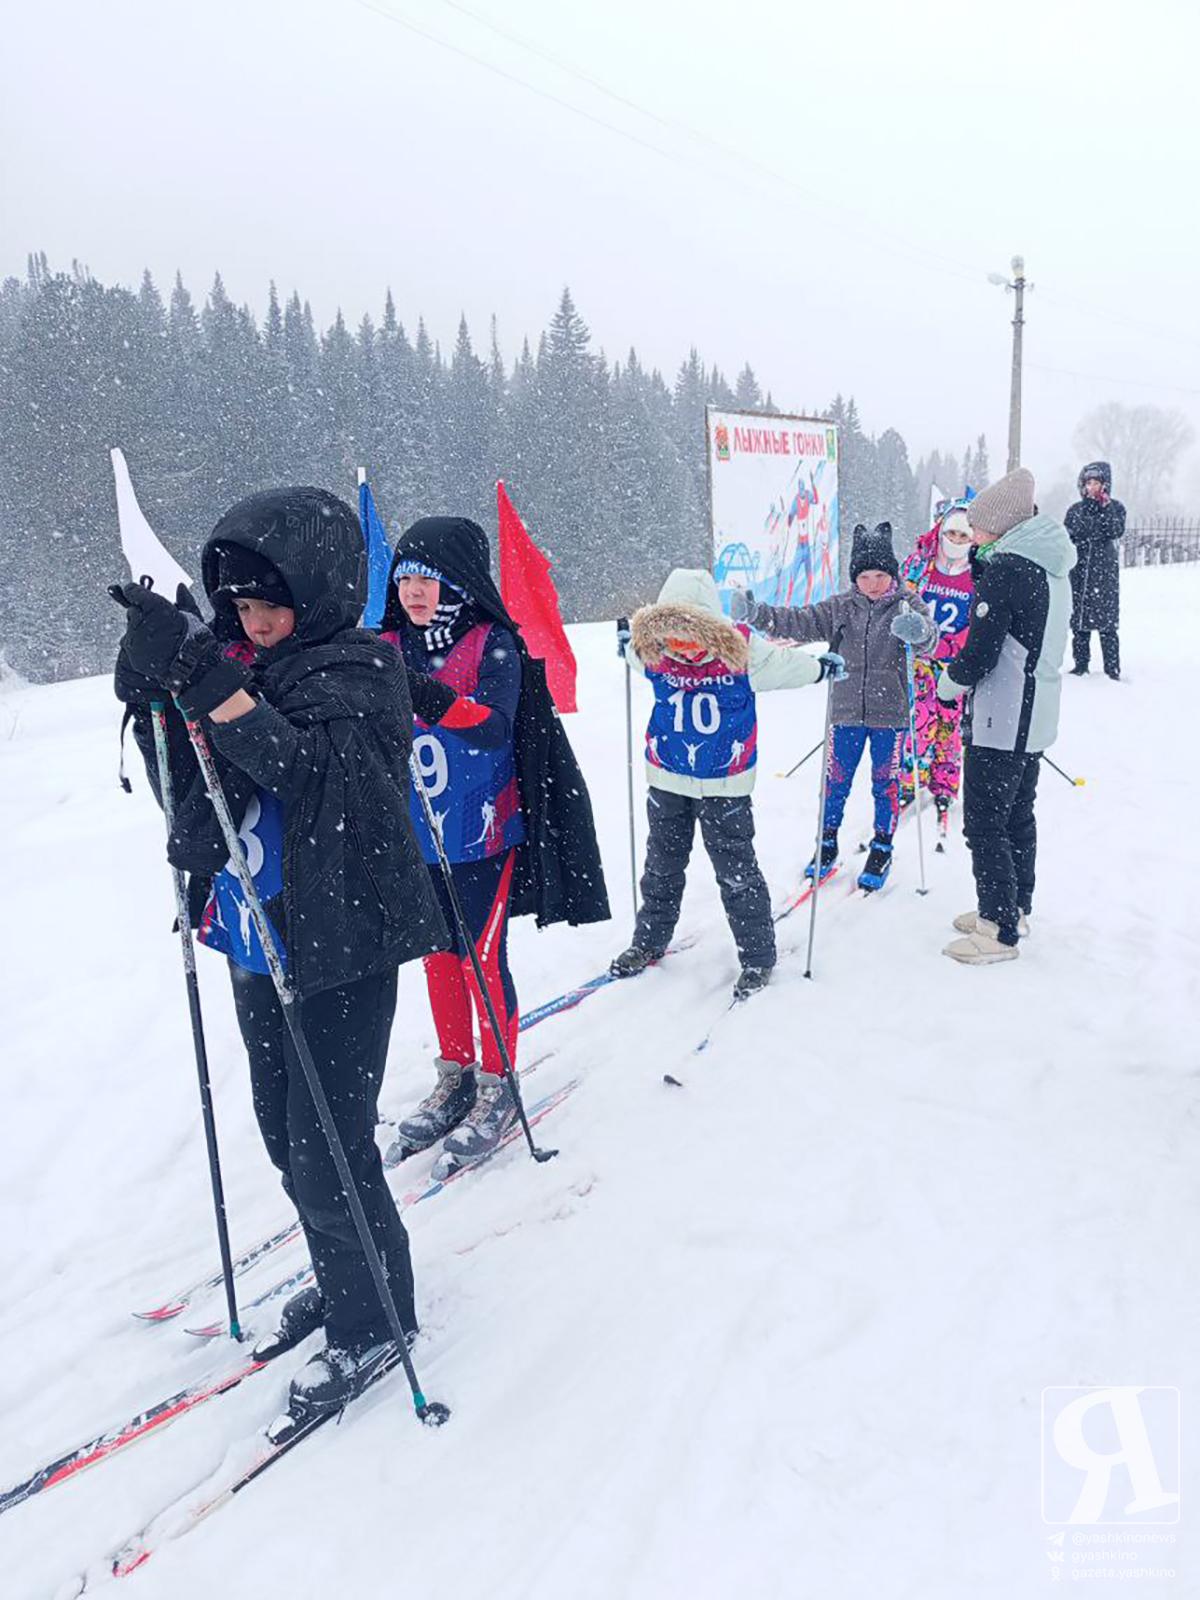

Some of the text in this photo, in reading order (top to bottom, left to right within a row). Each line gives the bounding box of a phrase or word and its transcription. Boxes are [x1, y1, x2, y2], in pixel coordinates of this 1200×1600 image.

[734, 426, 825, 457] ЛЫЖНЫЕ ГОНКИ
[927, 599, 959, 633] 12
[667, 690, 721, 735] 10
[412, 734, 449, 799] 9
